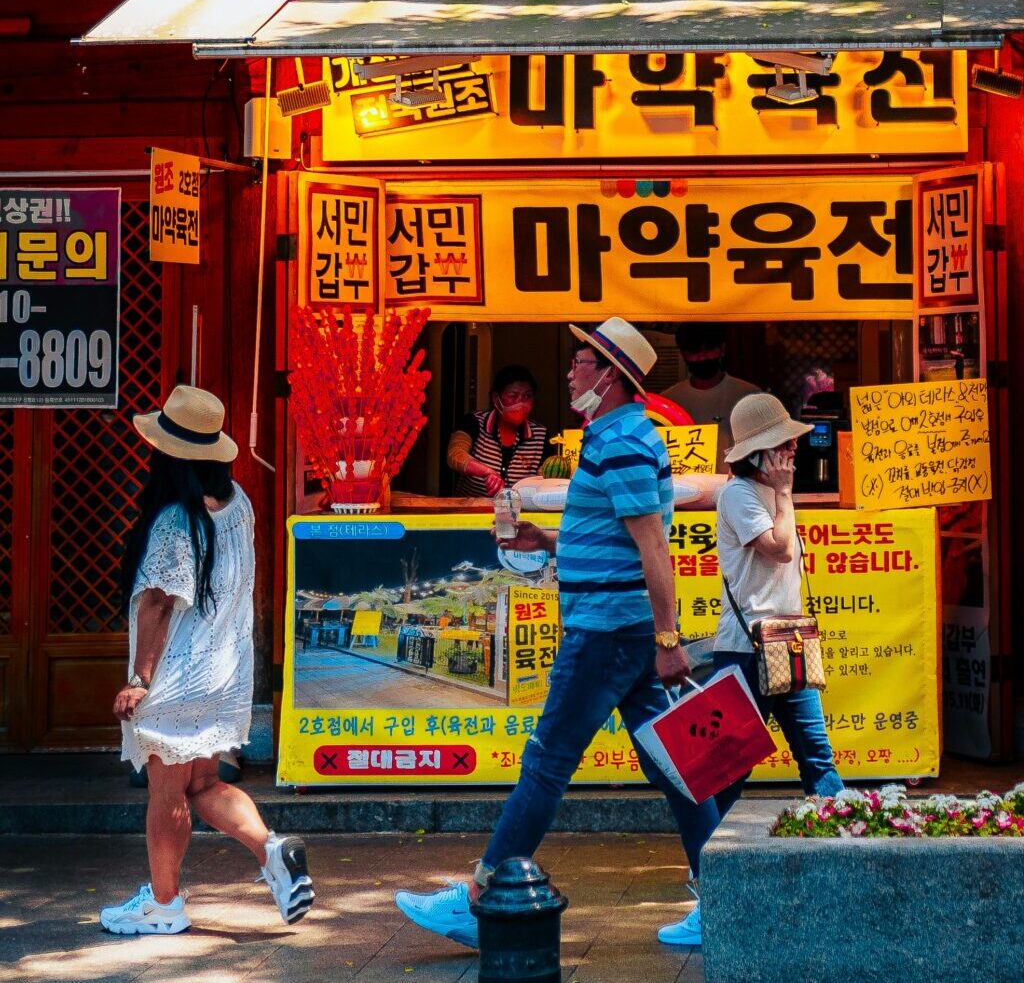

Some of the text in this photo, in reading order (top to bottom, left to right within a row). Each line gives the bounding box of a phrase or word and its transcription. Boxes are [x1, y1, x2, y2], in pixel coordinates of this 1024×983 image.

[154, 161, 174, 194] 원조
[179, 170, 199, 197] 2호점
[152, 205, 199, 246] 마약육전
[317, 199, 368, 246] 서민
[387, 206, 466, 247] 서민
[927, 189, 970, 240] 서민
[0, 231, 108, 280] 문의
[512, 199, 913, 303] 마약육전
[684, 428, 709, 462] 곳
[670, 555, 719, 576] 점을
[826, 550, 919, 574] 않습니다.
[514, 589, 539, 600] Since
[514, 602, 547, 621] 원조
[515, 623, 558, 645] 마약
[839, 646, 869, 659] 알리고
[873, 643, 916, 658] 있습니다.
[839, 663, 872, 676] 있지만,
[299, 715, 375, 736] 2호점에서
[383, 716, 416, 736] 구입
[425, 715, 496, 736] 후(육전과
[873, 711, 919, 730] 운영중
[347, 749, 441, 770] 절대금지
